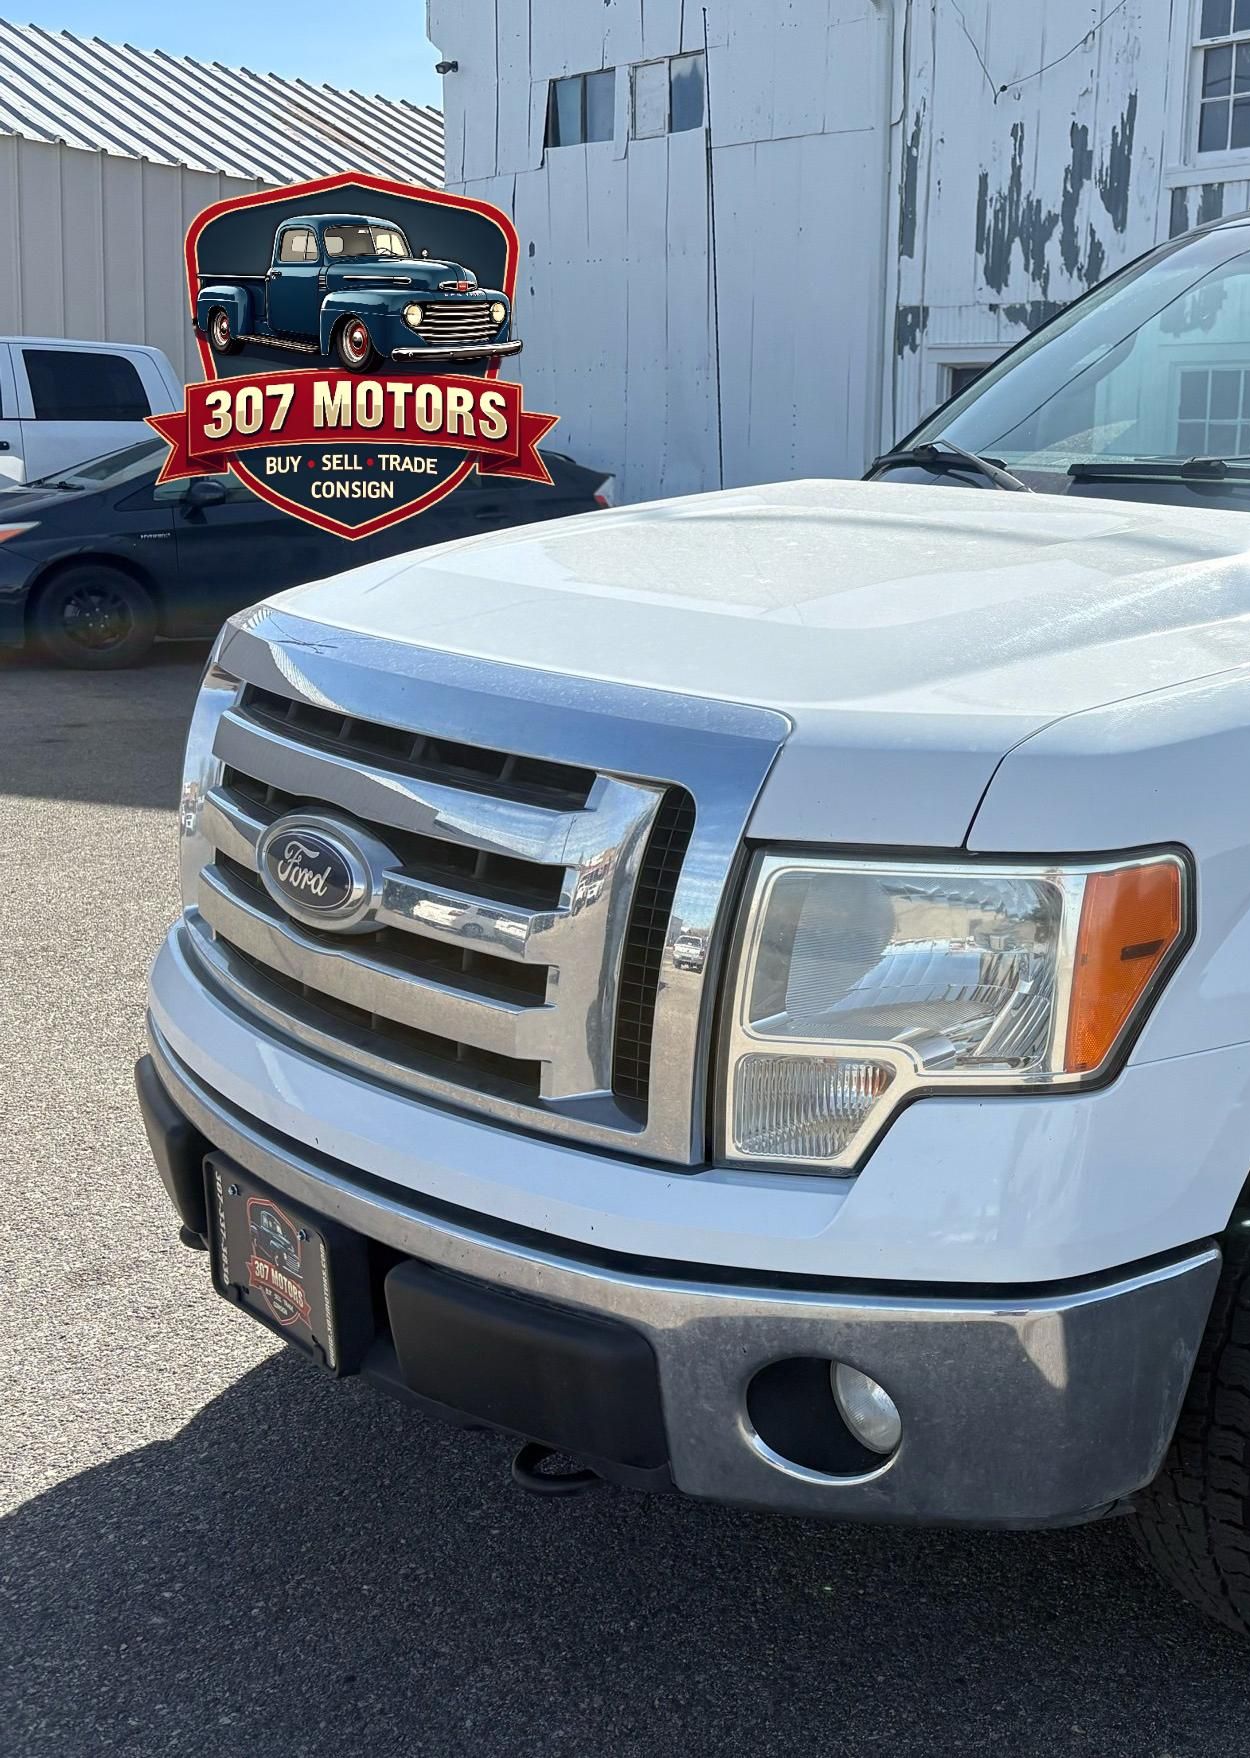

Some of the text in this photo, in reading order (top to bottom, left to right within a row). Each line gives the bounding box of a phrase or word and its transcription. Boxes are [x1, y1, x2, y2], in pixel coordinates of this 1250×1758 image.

[277, 840, 332, 897] Ford
[254, 1260, 269, 1281] 307
[271, 1267, 304, 1308] MOTORS
